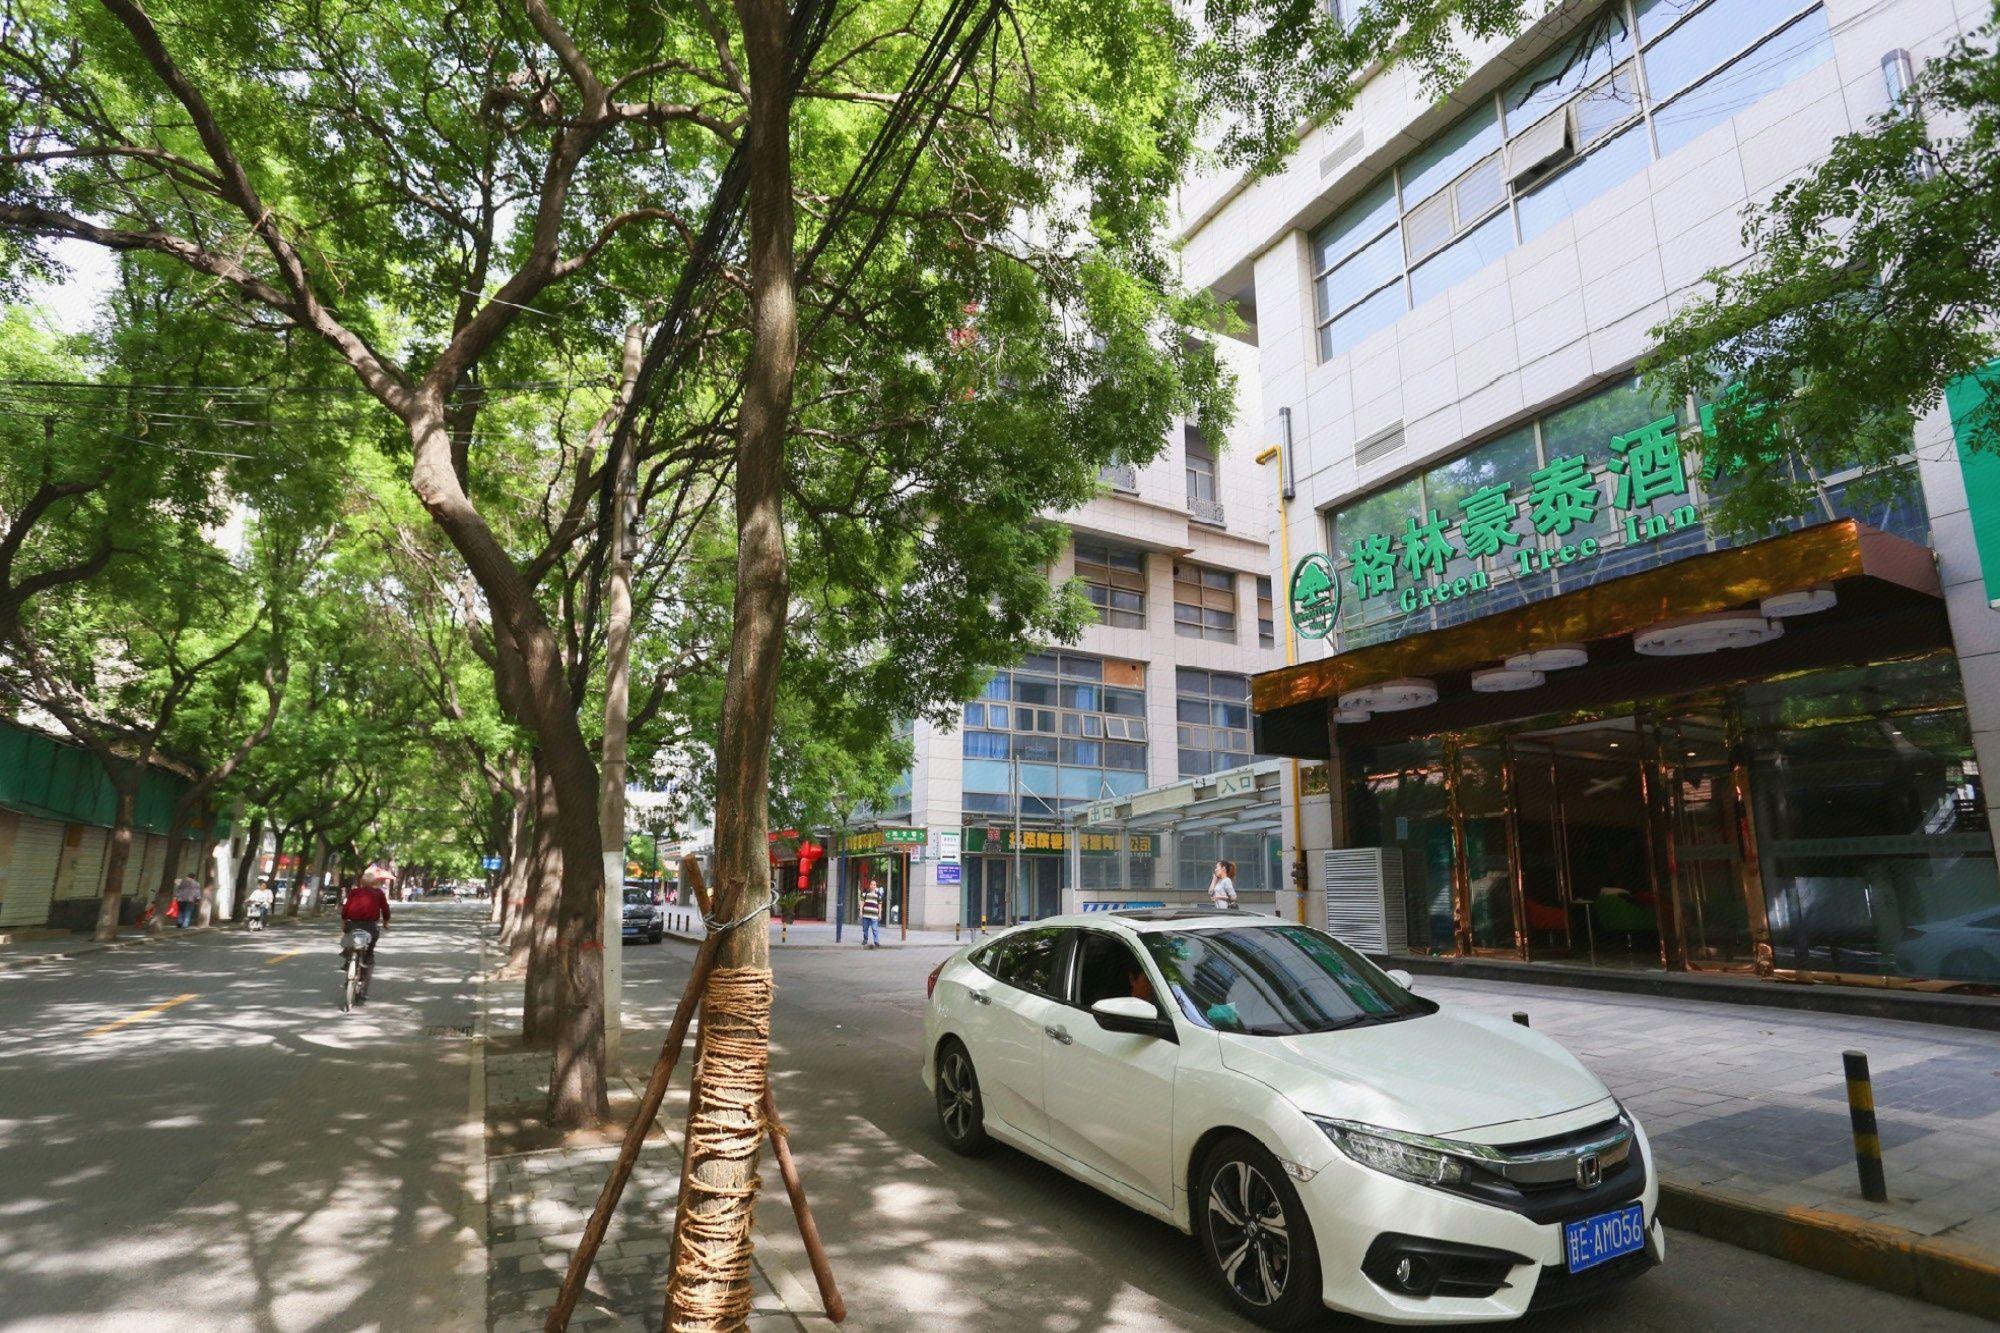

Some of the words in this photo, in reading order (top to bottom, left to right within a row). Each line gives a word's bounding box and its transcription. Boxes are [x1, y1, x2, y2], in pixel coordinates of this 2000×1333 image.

[1400, 570, 1488, 614] Green
[1513, 537, 1597, 578] Tree
[1622, 504, 1698, 547] Inn
[1221, 776, 1251, 794] 入口
[1090, 803, 1113, 822] 出口
